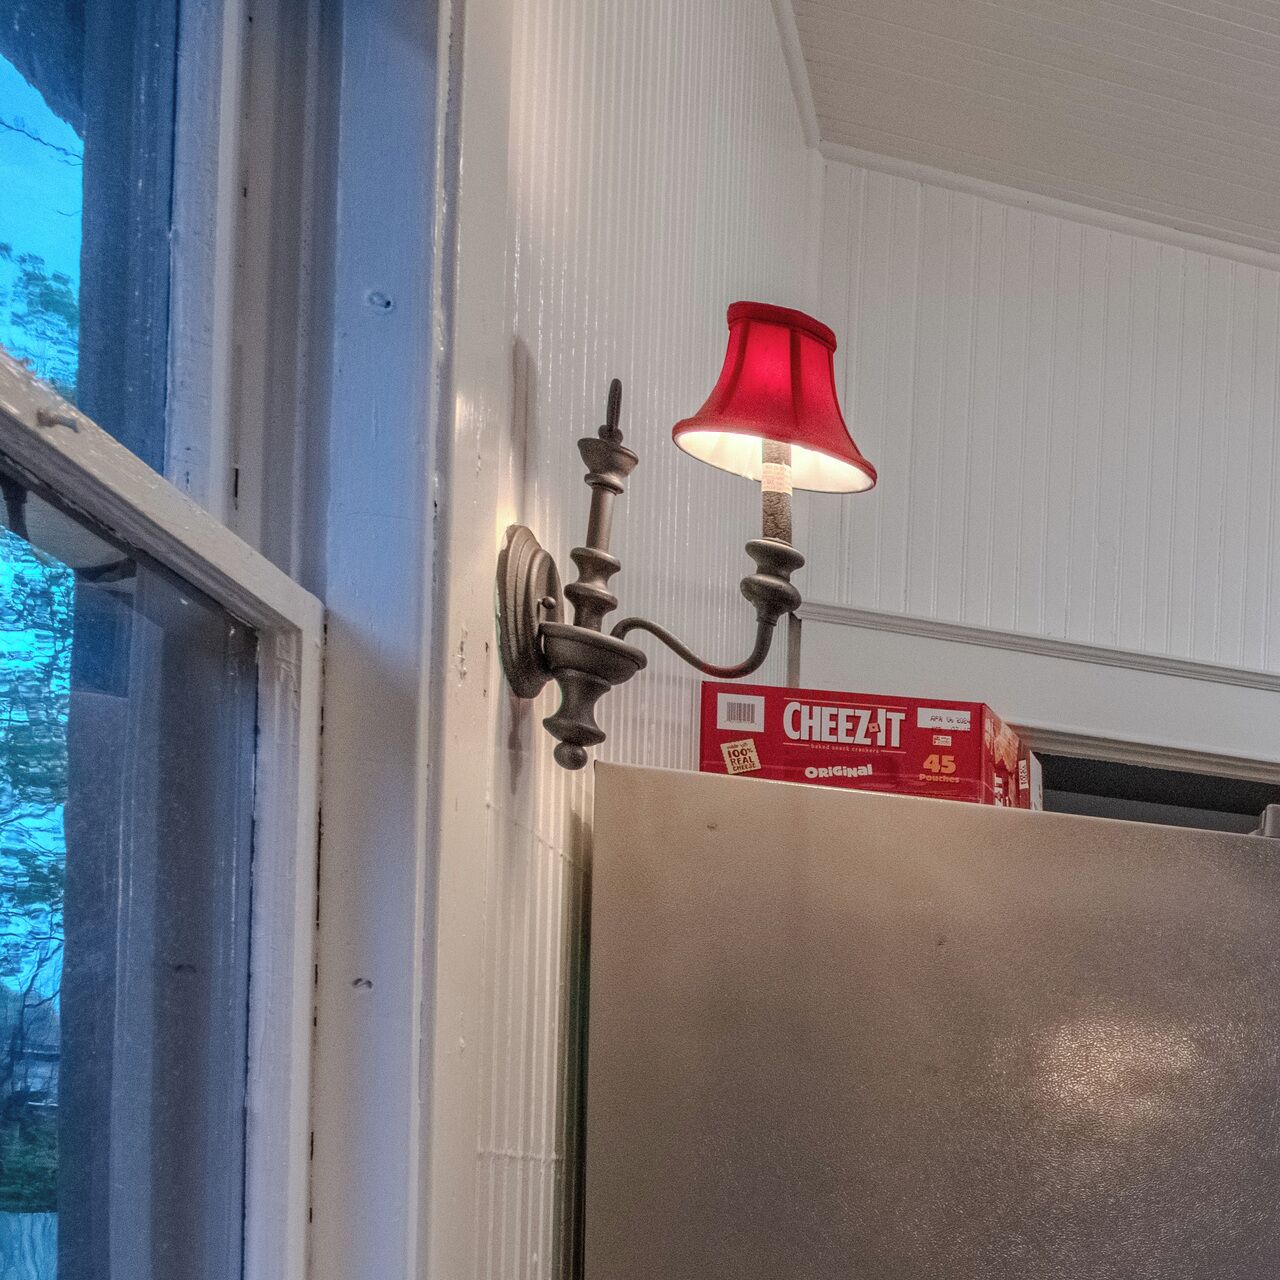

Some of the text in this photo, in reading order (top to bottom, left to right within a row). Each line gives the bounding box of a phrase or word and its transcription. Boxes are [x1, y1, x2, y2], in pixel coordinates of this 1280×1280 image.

[727, 747, 753, 758] 100%
[730, 756, 755, 767] REAL
[733, 763, 756, 771] CHEESE
[922, 753, 957, 774] 45
[918, 773, 960, 783] Pouches
